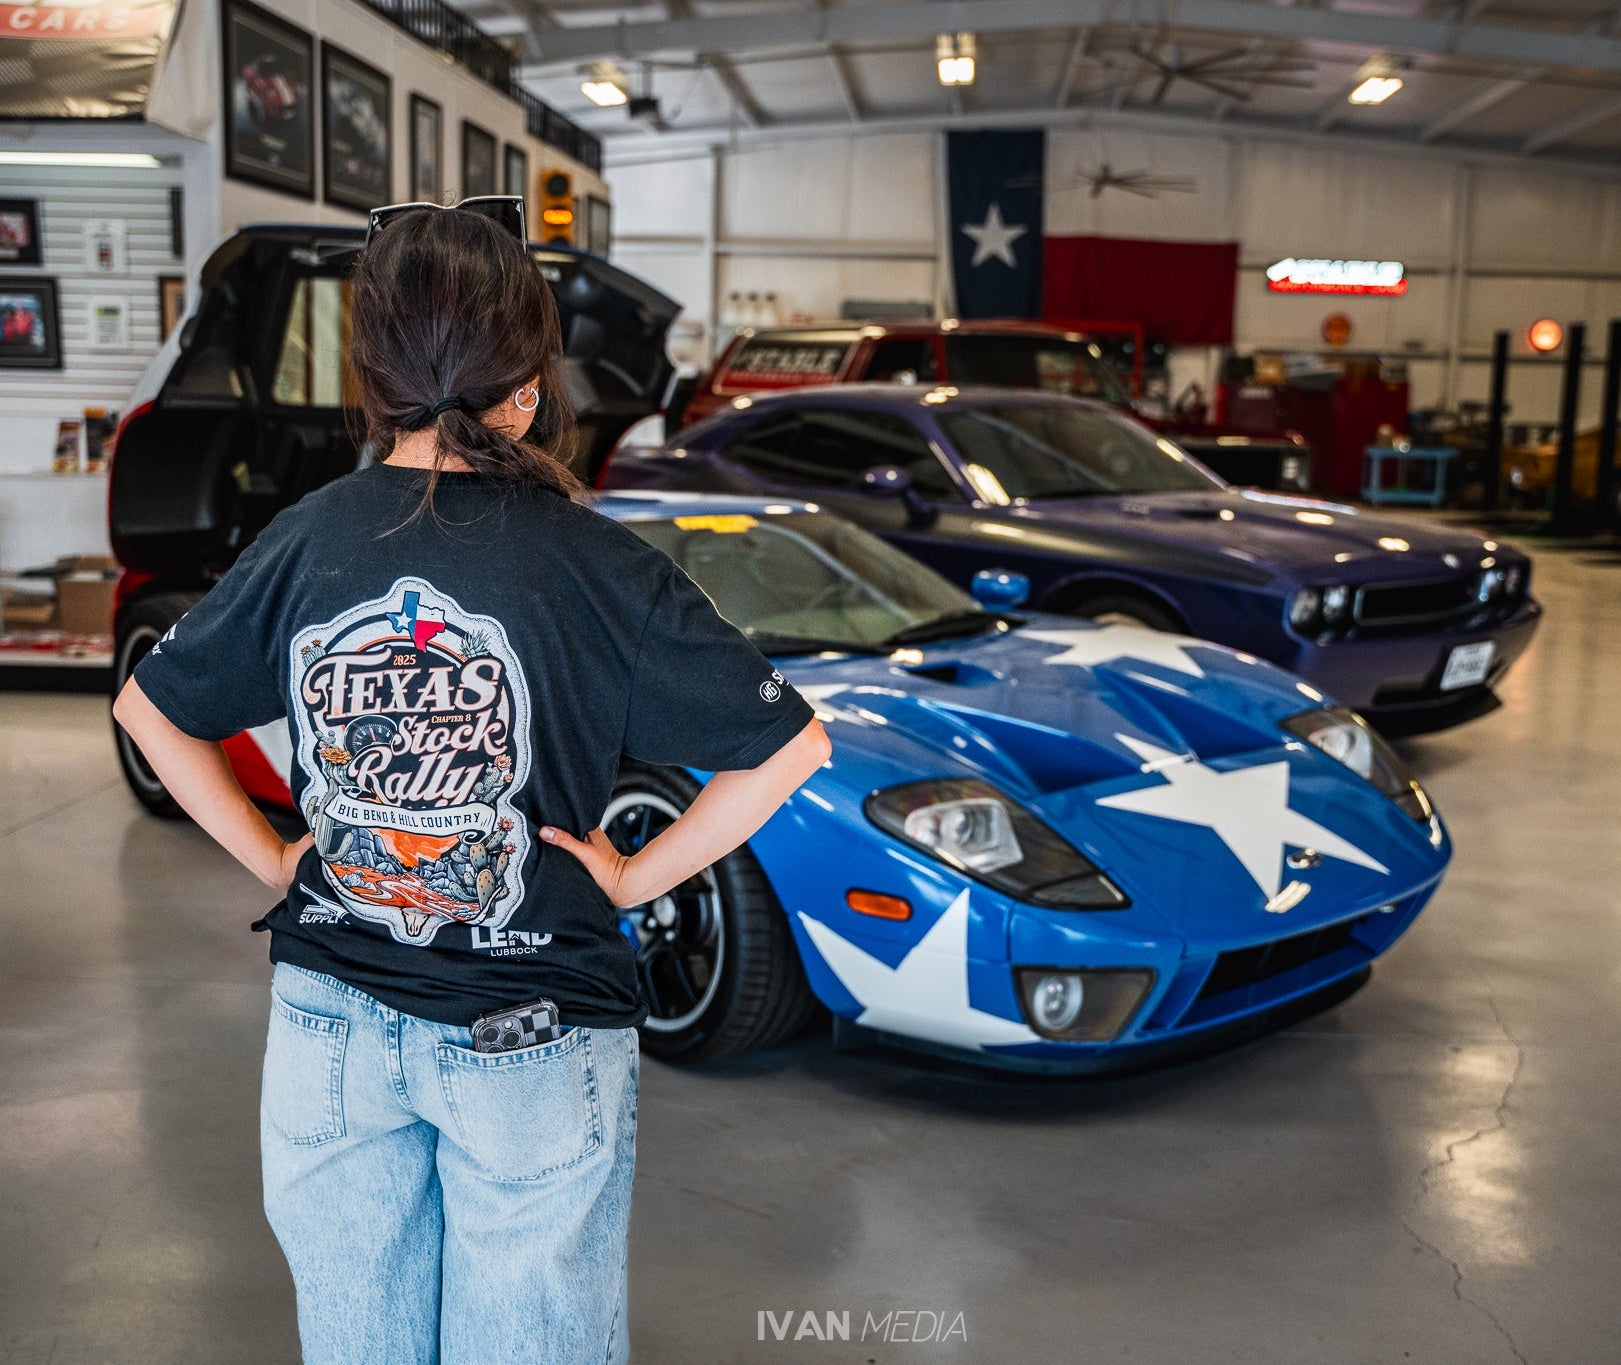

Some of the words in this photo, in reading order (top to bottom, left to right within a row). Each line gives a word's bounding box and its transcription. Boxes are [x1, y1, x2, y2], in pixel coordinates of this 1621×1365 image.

[9, 7, 131, 31] CARS
[393, 654, 417, 666] 2025
[302, 647, 503, 719] TEXAS
[431, 715, 464, 724] CHAPTER
[465, 713, 472, 722] 8
[391, 707, 508, 756] Stock
[348, 745, 485, 806] Rally
[337, 803, 359, 819] BIG
[363, 809, 389, 823] BEND
[390, 811, 397, 823] &
[399, 813, 419, 827] HILL
[420, 812, 481, 828] COUNTRY
[490, 946, 538, 957] LUBBOCK
